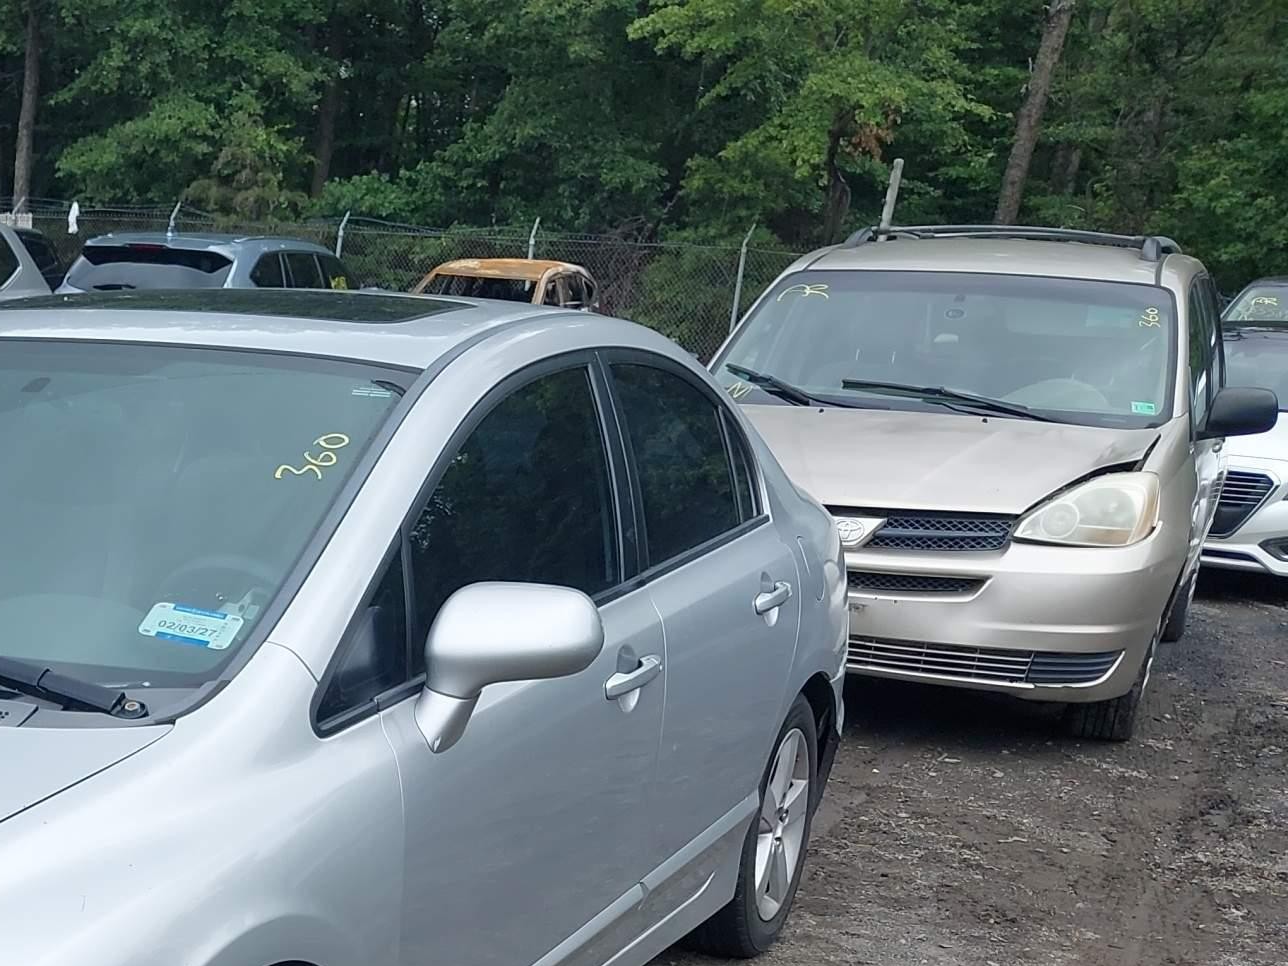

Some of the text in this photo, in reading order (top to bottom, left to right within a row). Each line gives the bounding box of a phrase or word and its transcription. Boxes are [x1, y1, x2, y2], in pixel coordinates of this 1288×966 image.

[1138, 307, 1161, 328] 360
[274, 432, 350, 480] 360
[157, 619, 217, 637] 02/03/27
